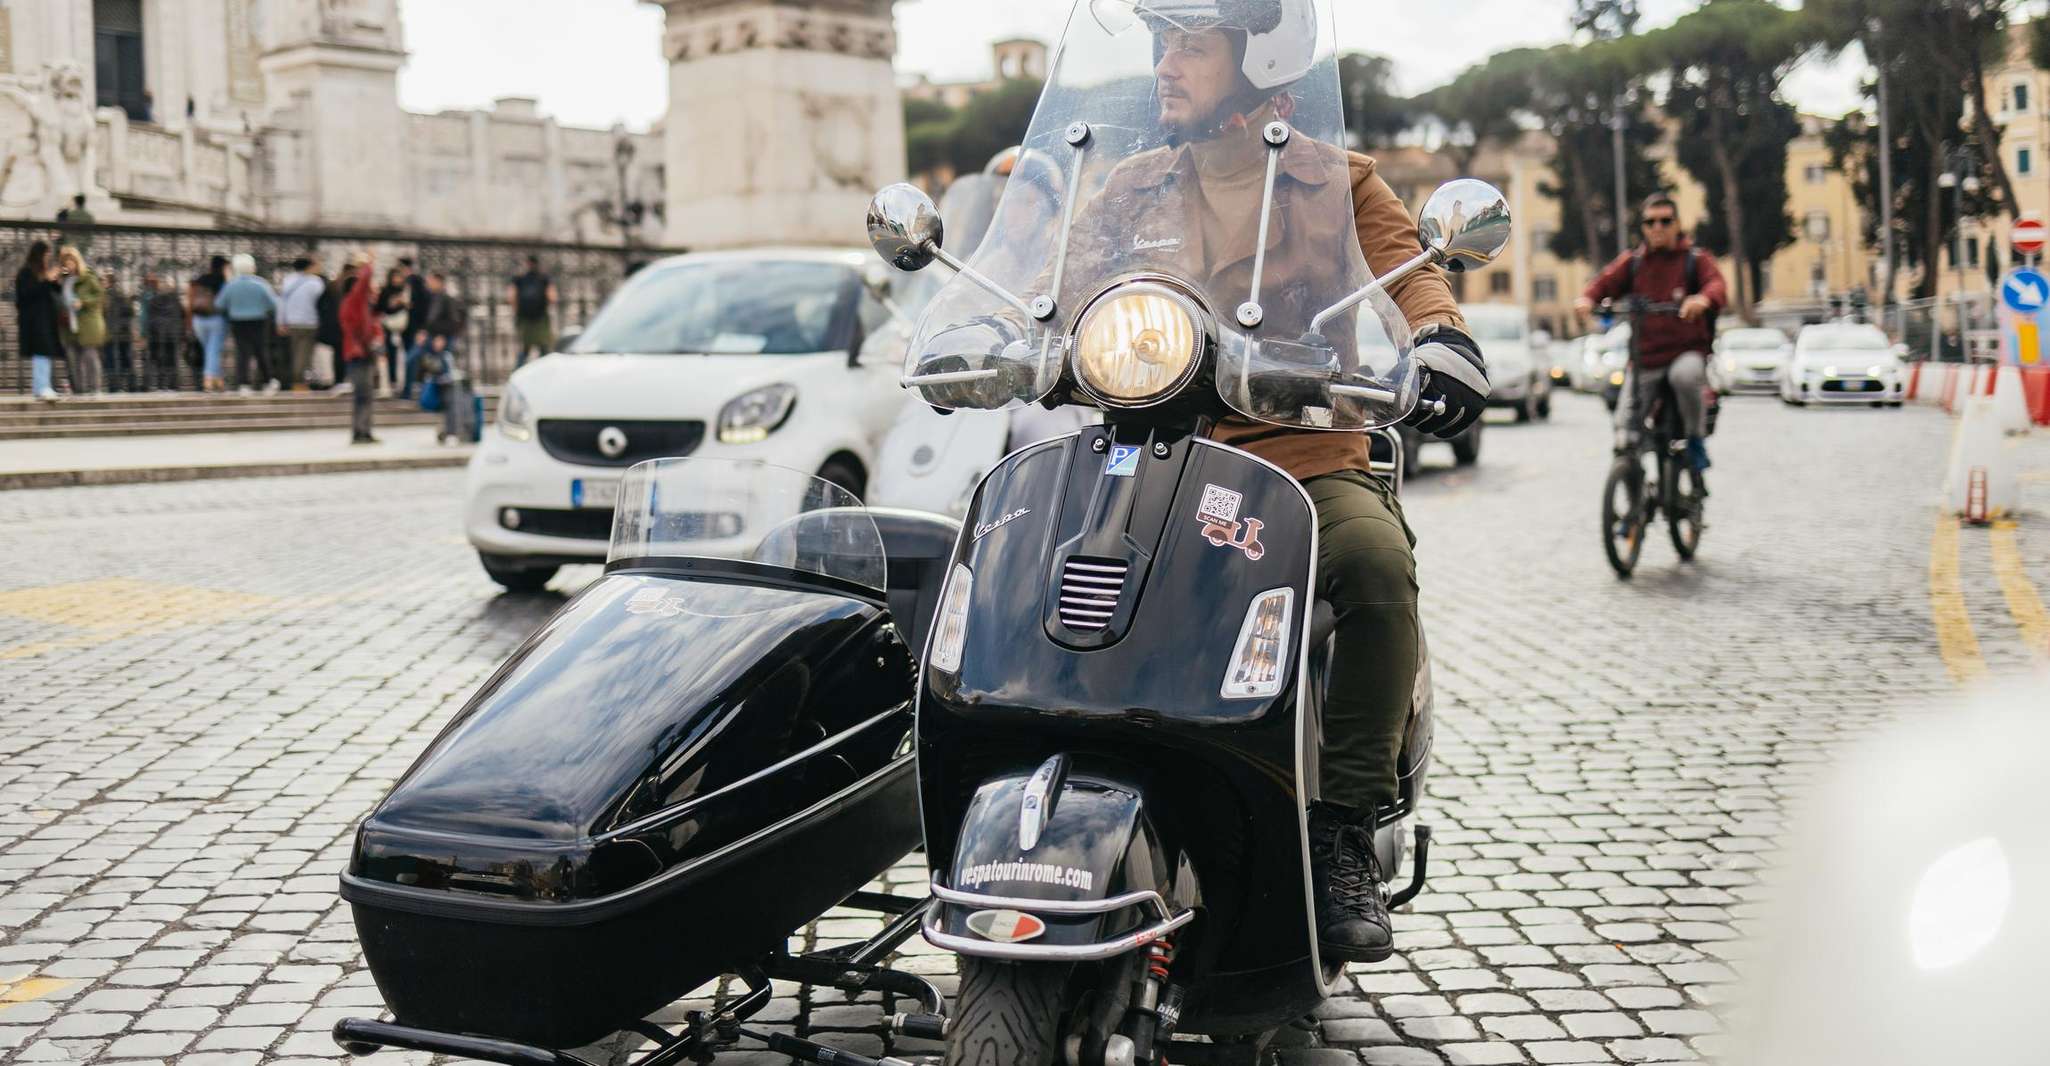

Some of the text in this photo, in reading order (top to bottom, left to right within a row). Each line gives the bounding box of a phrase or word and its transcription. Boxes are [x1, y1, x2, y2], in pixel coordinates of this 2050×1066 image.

[1111, 447, 1129, 465] P
[972, 507, 1031, 544] Vespa
[960, 857, 1093, 891] vespatourinrome.com
